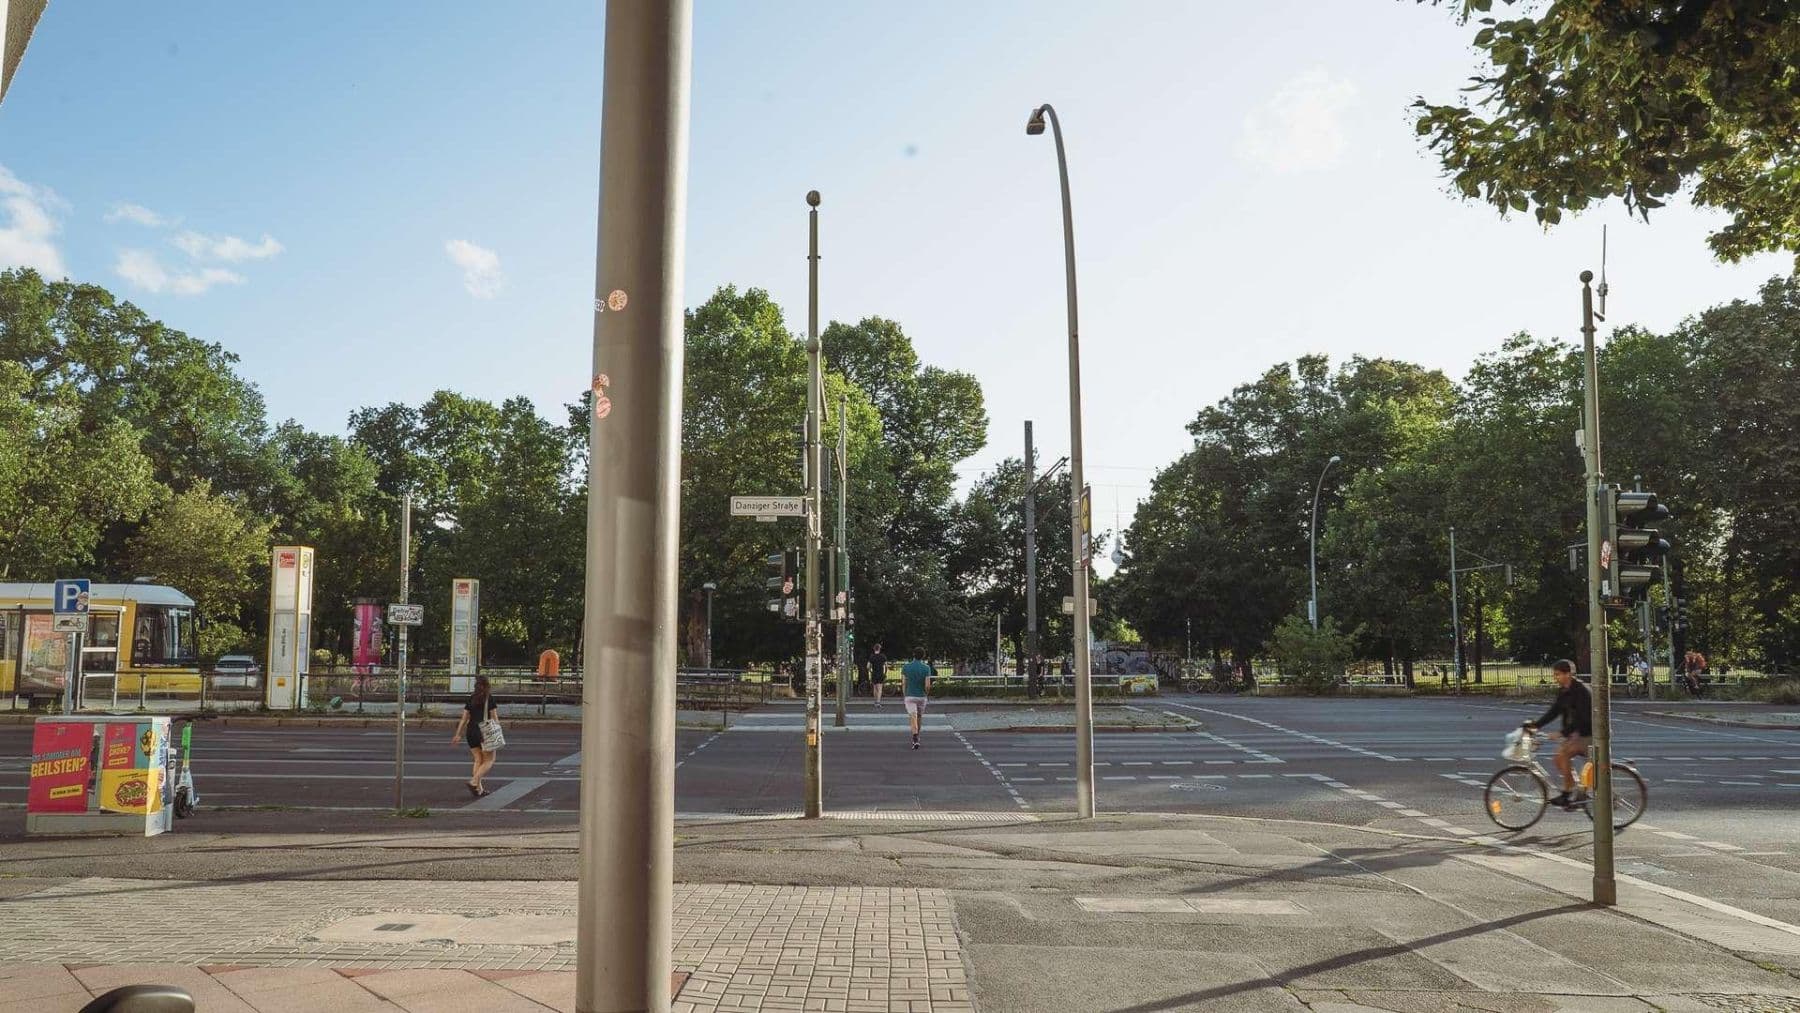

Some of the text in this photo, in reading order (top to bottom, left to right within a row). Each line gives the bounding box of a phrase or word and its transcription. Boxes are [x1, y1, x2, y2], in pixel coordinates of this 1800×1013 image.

[735, 501, 799, 511] Danziger Straße
[63, 584, 81, 609] P
[32, 757, 87, 777] GEILSTEN?
